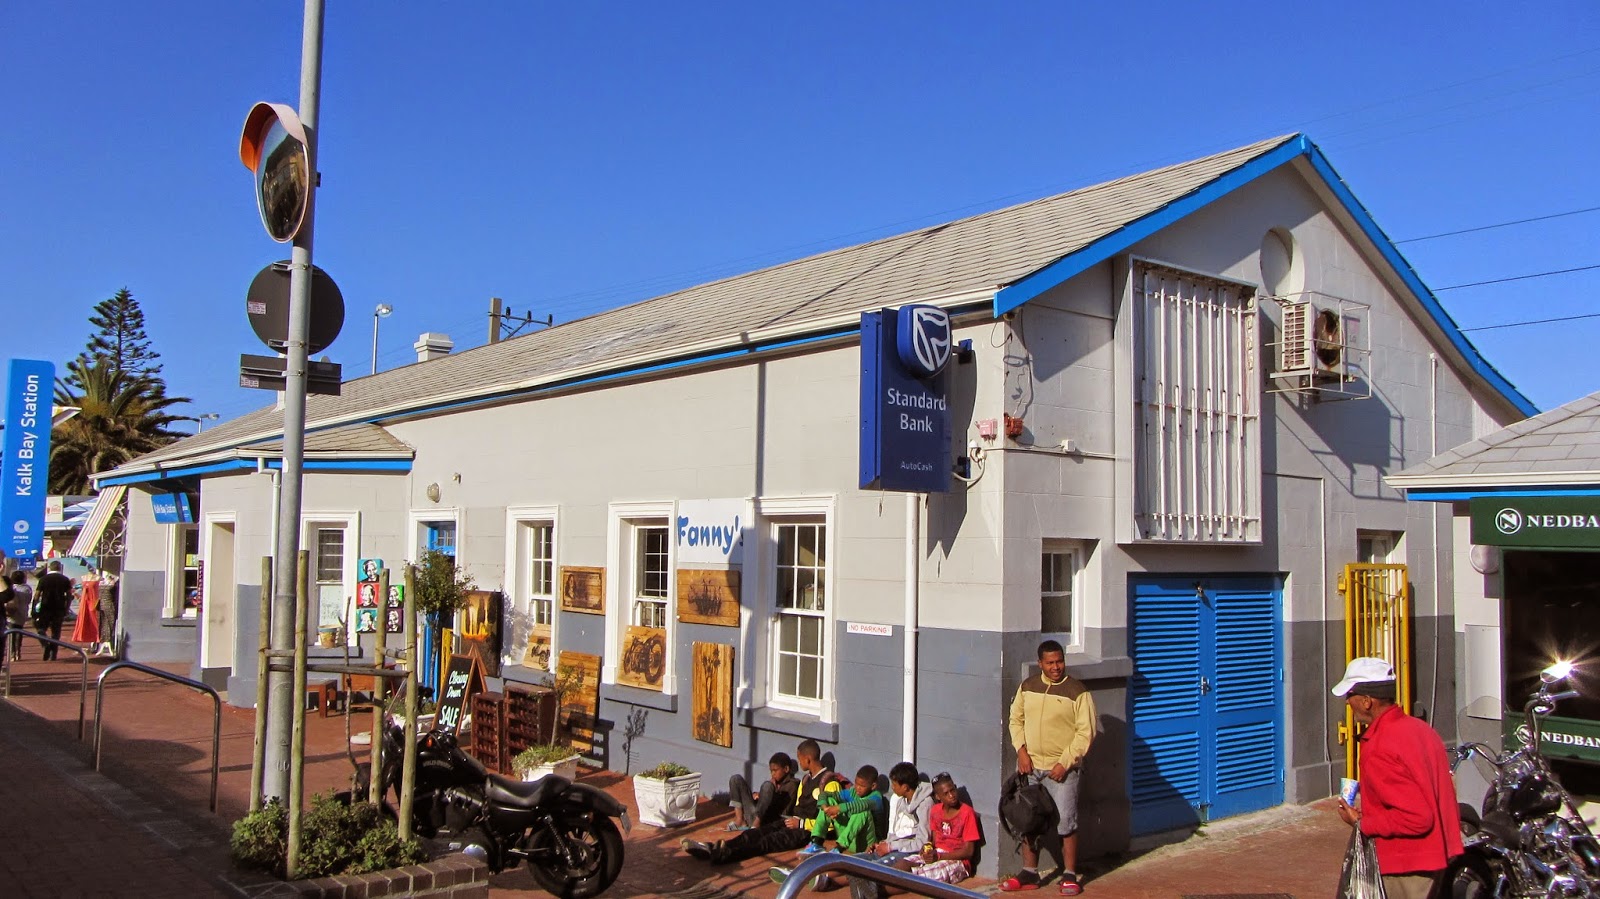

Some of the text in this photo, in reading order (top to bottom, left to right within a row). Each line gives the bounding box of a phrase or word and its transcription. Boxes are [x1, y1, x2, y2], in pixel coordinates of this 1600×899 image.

[887, 387, 946, 411] Standard
[900, 413, 933, 433] Bank
[16, 374, 39, 496] Kalk Bay Station
[900, 460, 933, 471] AutoCash
[1527, 514, 1600, 528] NEDBA
[850, 624, 887, 634] NO PARKING
[448, 670, 469, 689] Closing
[438, 705, 460, 727] SALE
